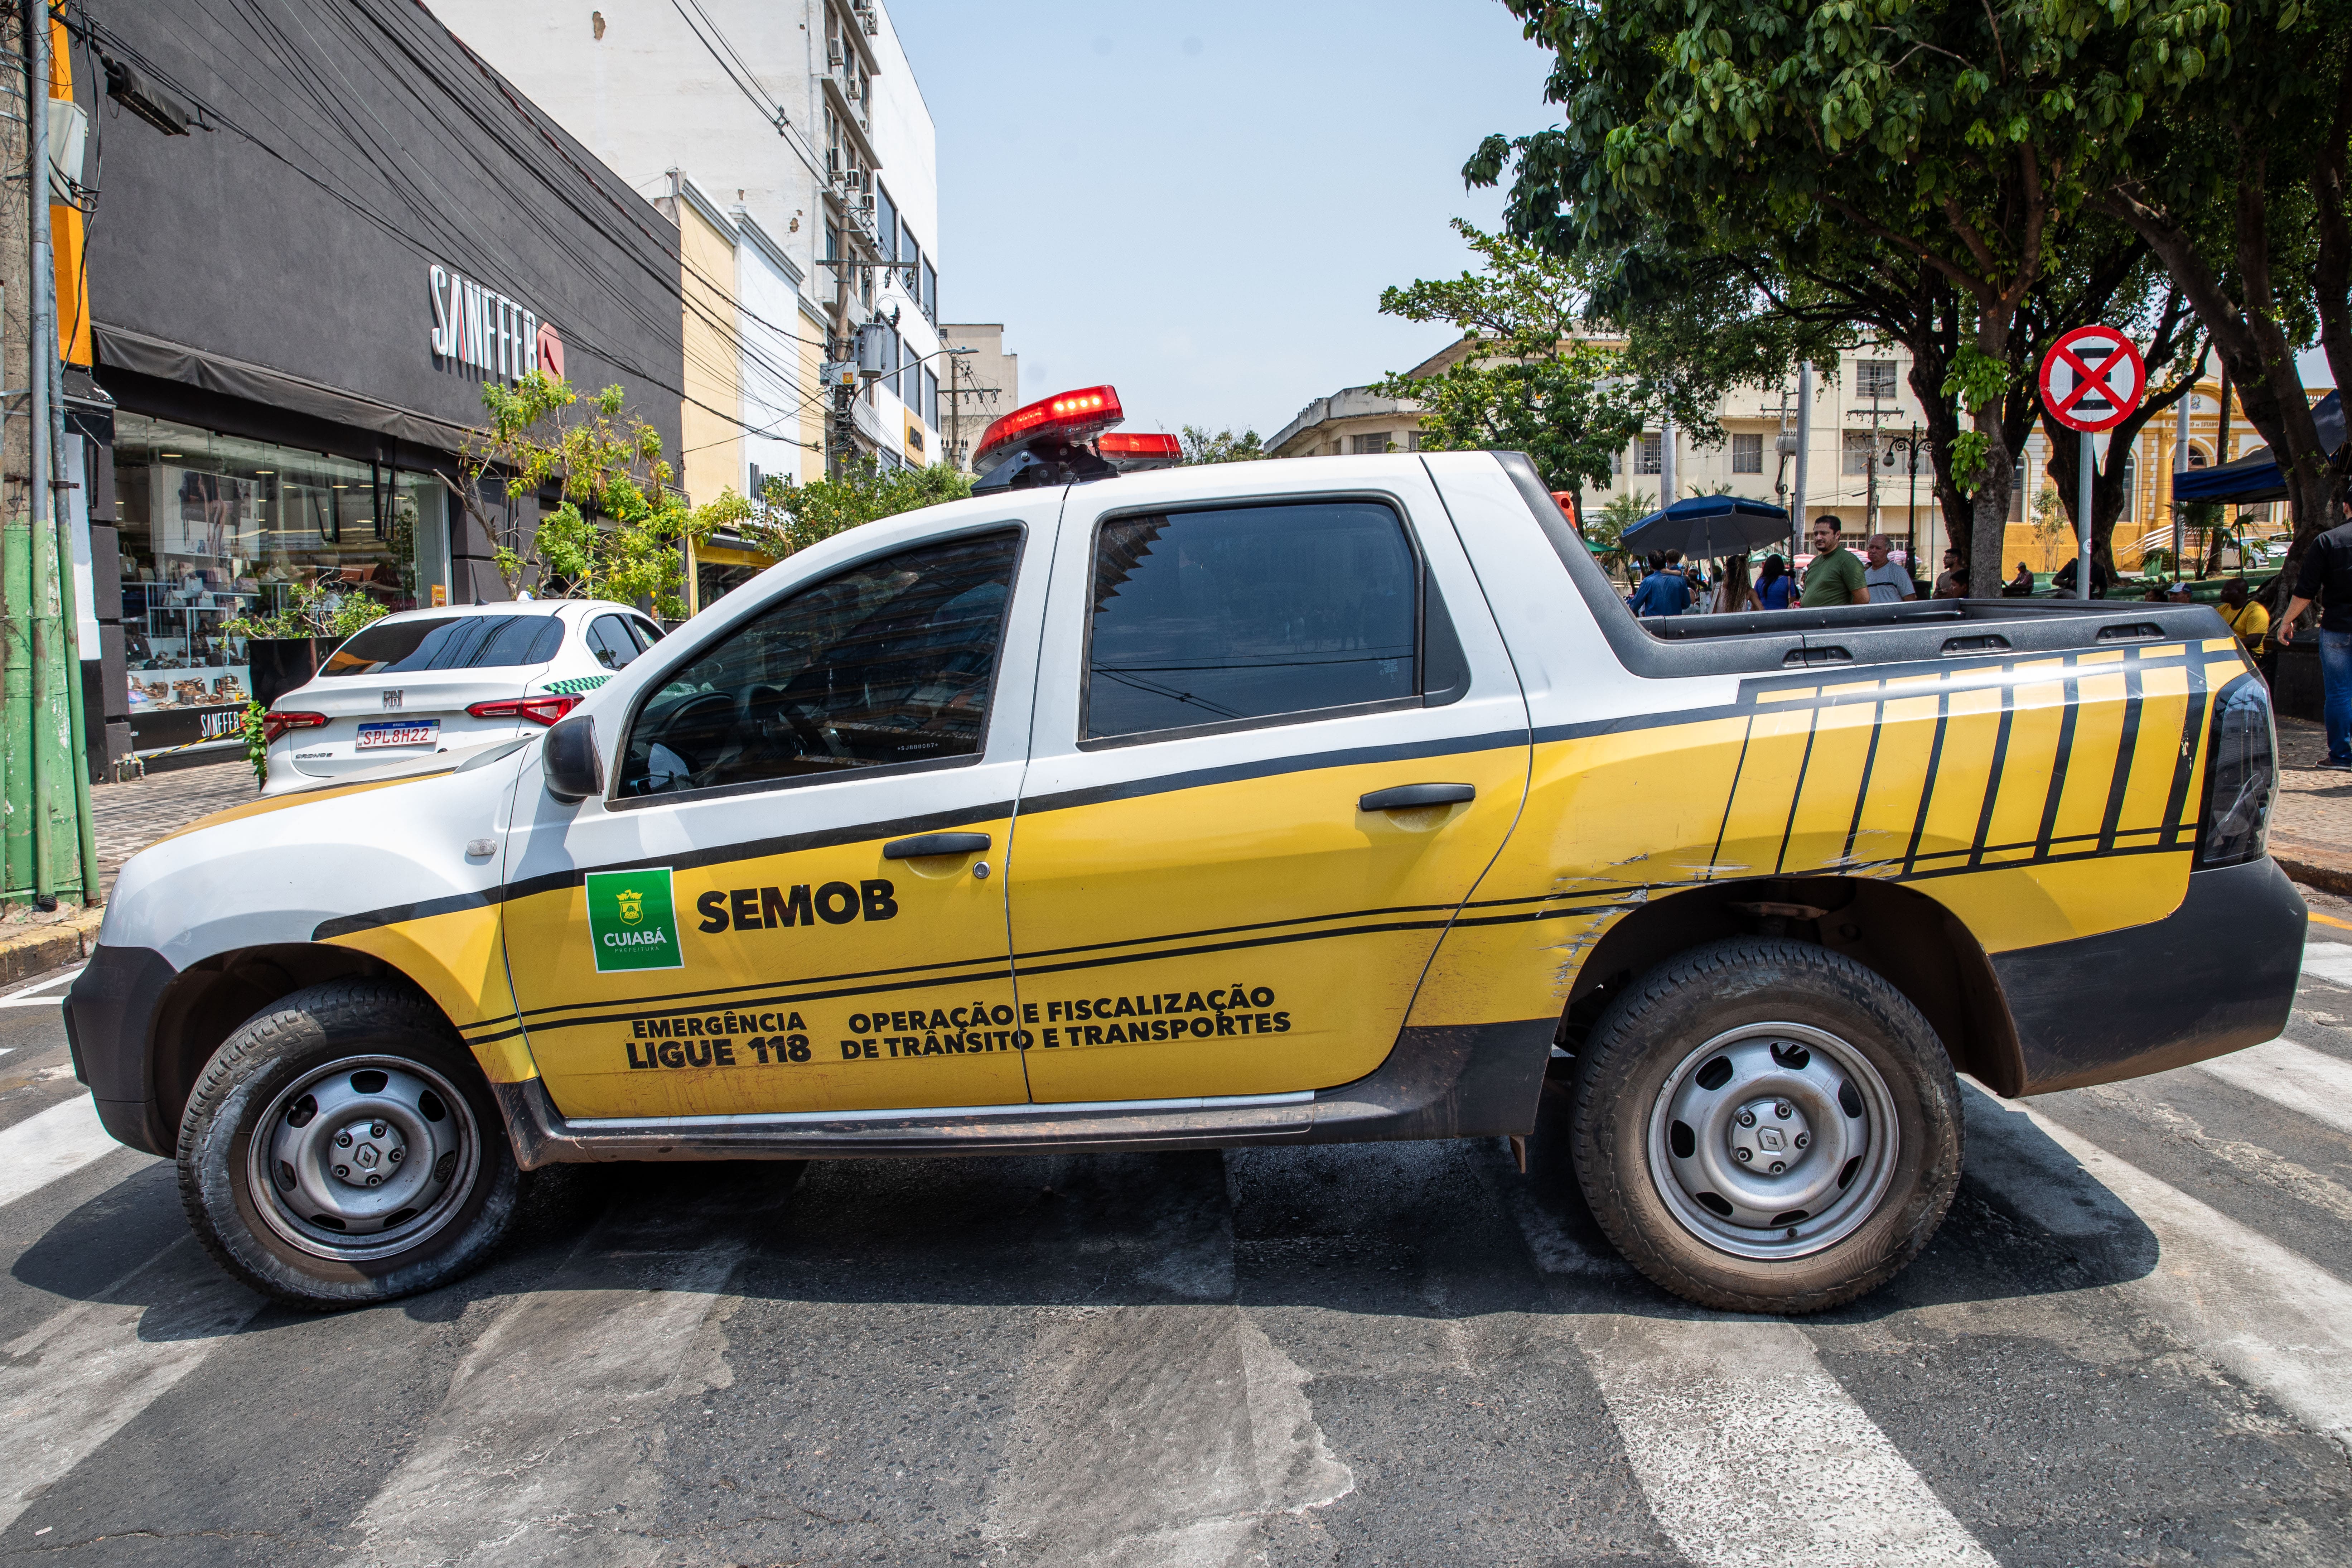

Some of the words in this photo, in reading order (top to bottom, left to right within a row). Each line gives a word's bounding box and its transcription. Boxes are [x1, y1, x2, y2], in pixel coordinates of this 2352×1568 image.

[383, 690, 403, 707] FIAT
[363, 728, 429, 745] SPL8H22
[697, 879, 899, 934] SEMOB
[604, 927, 667, 947] CUIABÁ
[849, 1001, 1014, 1034] OPERAÇÃO
[1022, 1003, 1040, 1024] E
[1047, 983, 1275, 1022] FISCALIZAÇÃO
[632, 1011, 807, 1039] EMERGÊNCIA
[840, 1038, 879, 1060] DE
[883, 1029, 1034, 1057] TRÂNSITO
[1042, 1028, 1060, 1048] E
[1064, 1012, 1291, 1047] TRANSPORTES
[626, 1038, 736, 1069] LIGUE
[747, 1034, 812, 1064] 118
